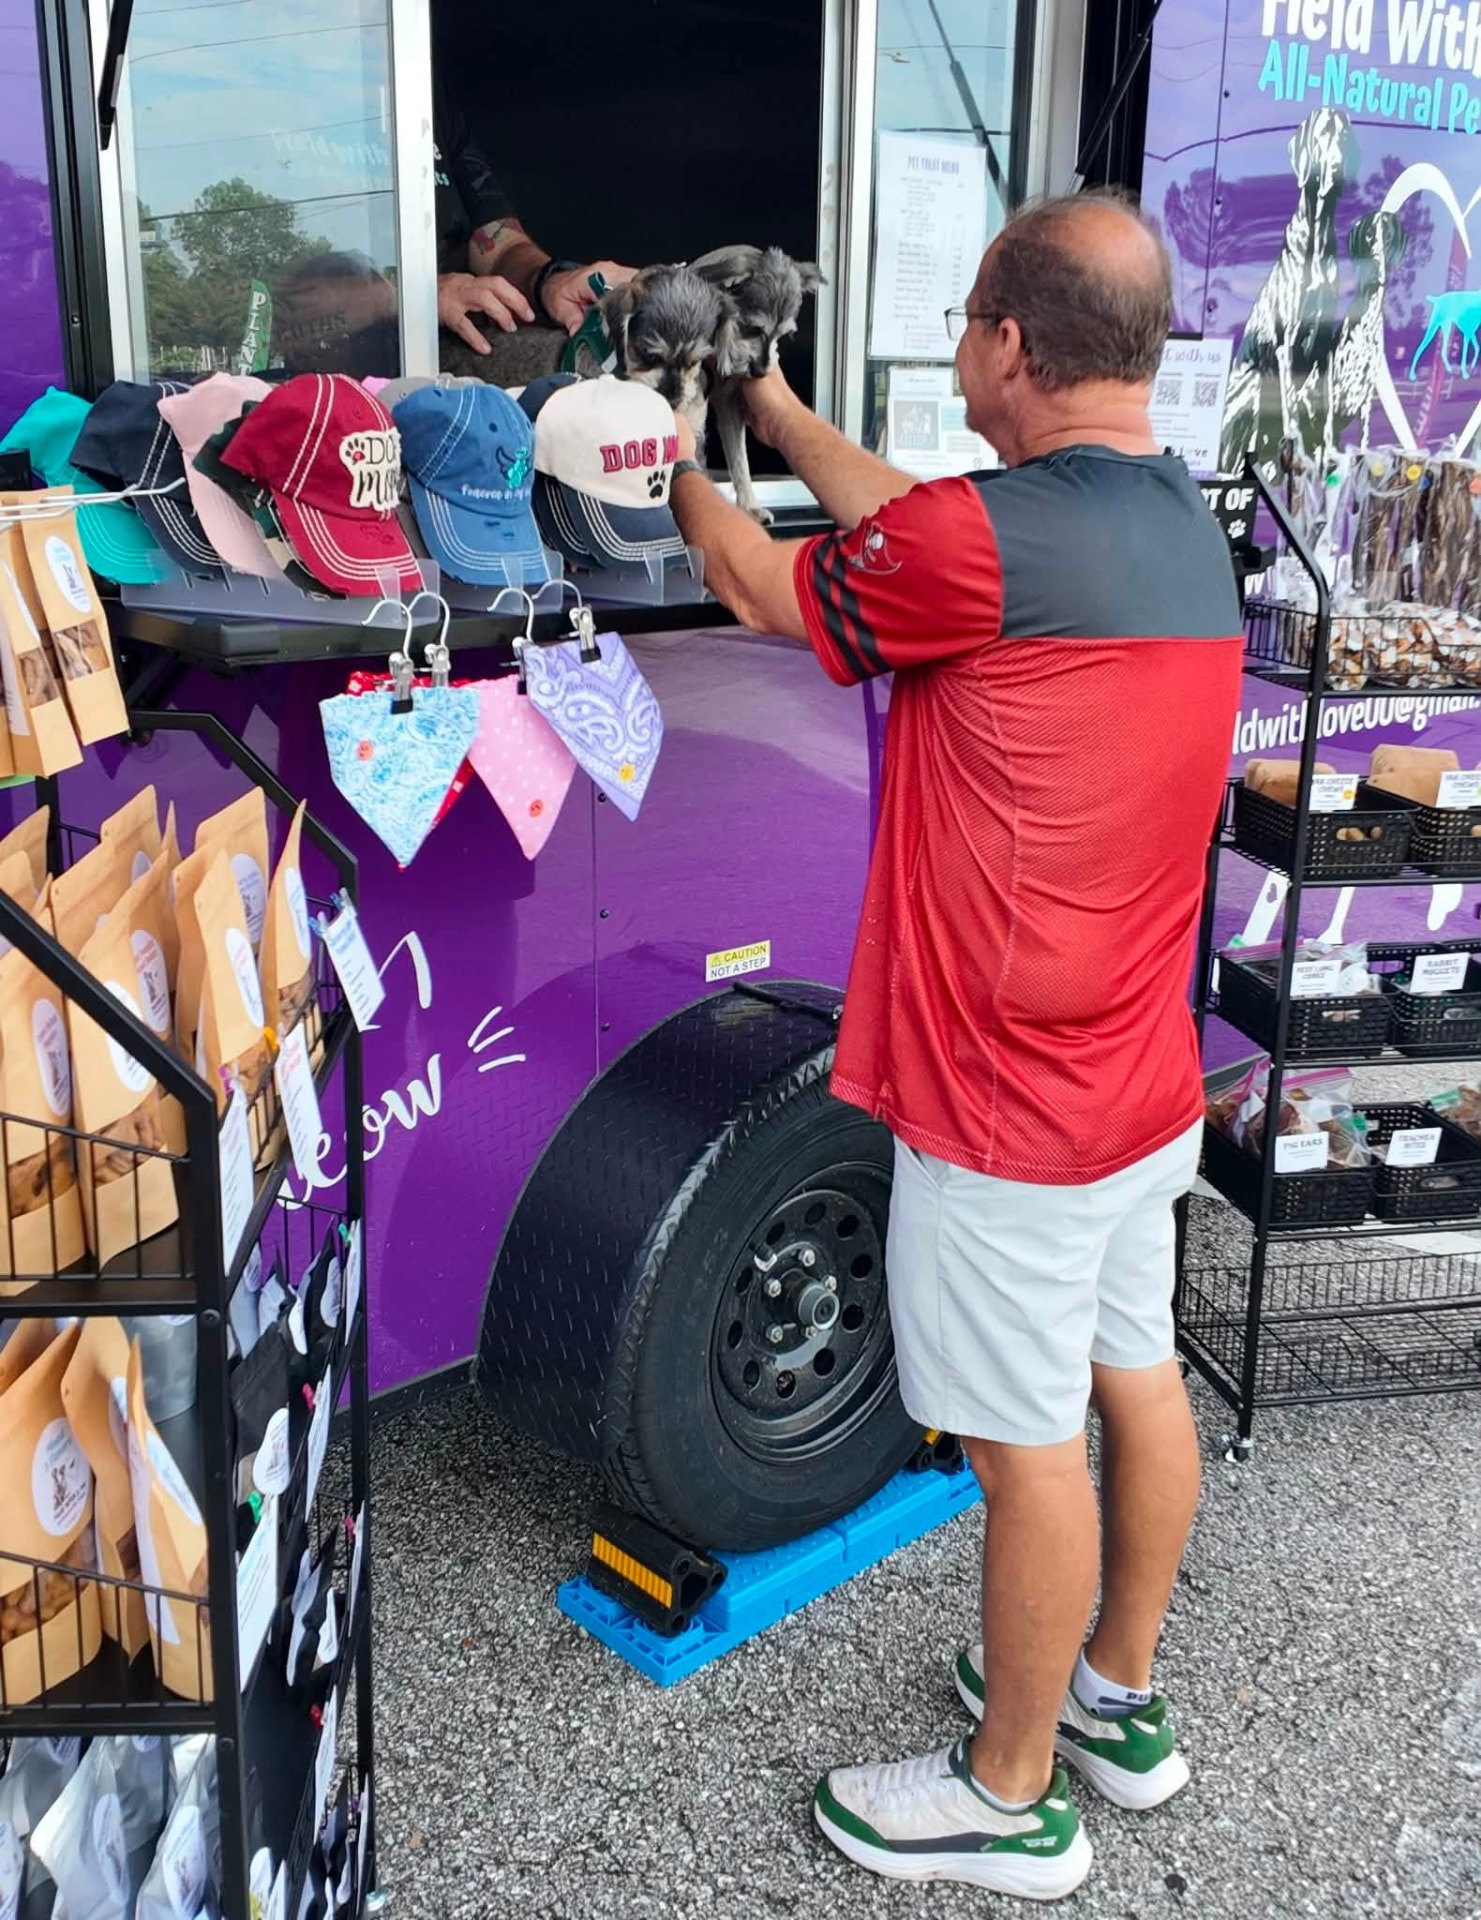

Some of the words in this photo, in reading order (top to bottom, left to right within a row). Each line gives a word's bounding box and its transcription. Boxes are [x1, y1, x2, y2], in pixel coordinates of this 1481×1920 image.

[1258, 38, 1444, 131] All-Natural
[599, 437, 658, 474] DOG
[1225, 487, 1255, 511] OF
[724, 944, 767, 962] CAUTION
[711, 966, 731, 979] NOT
[732, 964, 740, 974] A
[742, 957, 766, 971] STEP
[1283, 1141, 1299, 1150] PIG
[1300, 1138, 1323, 1147] EARS
